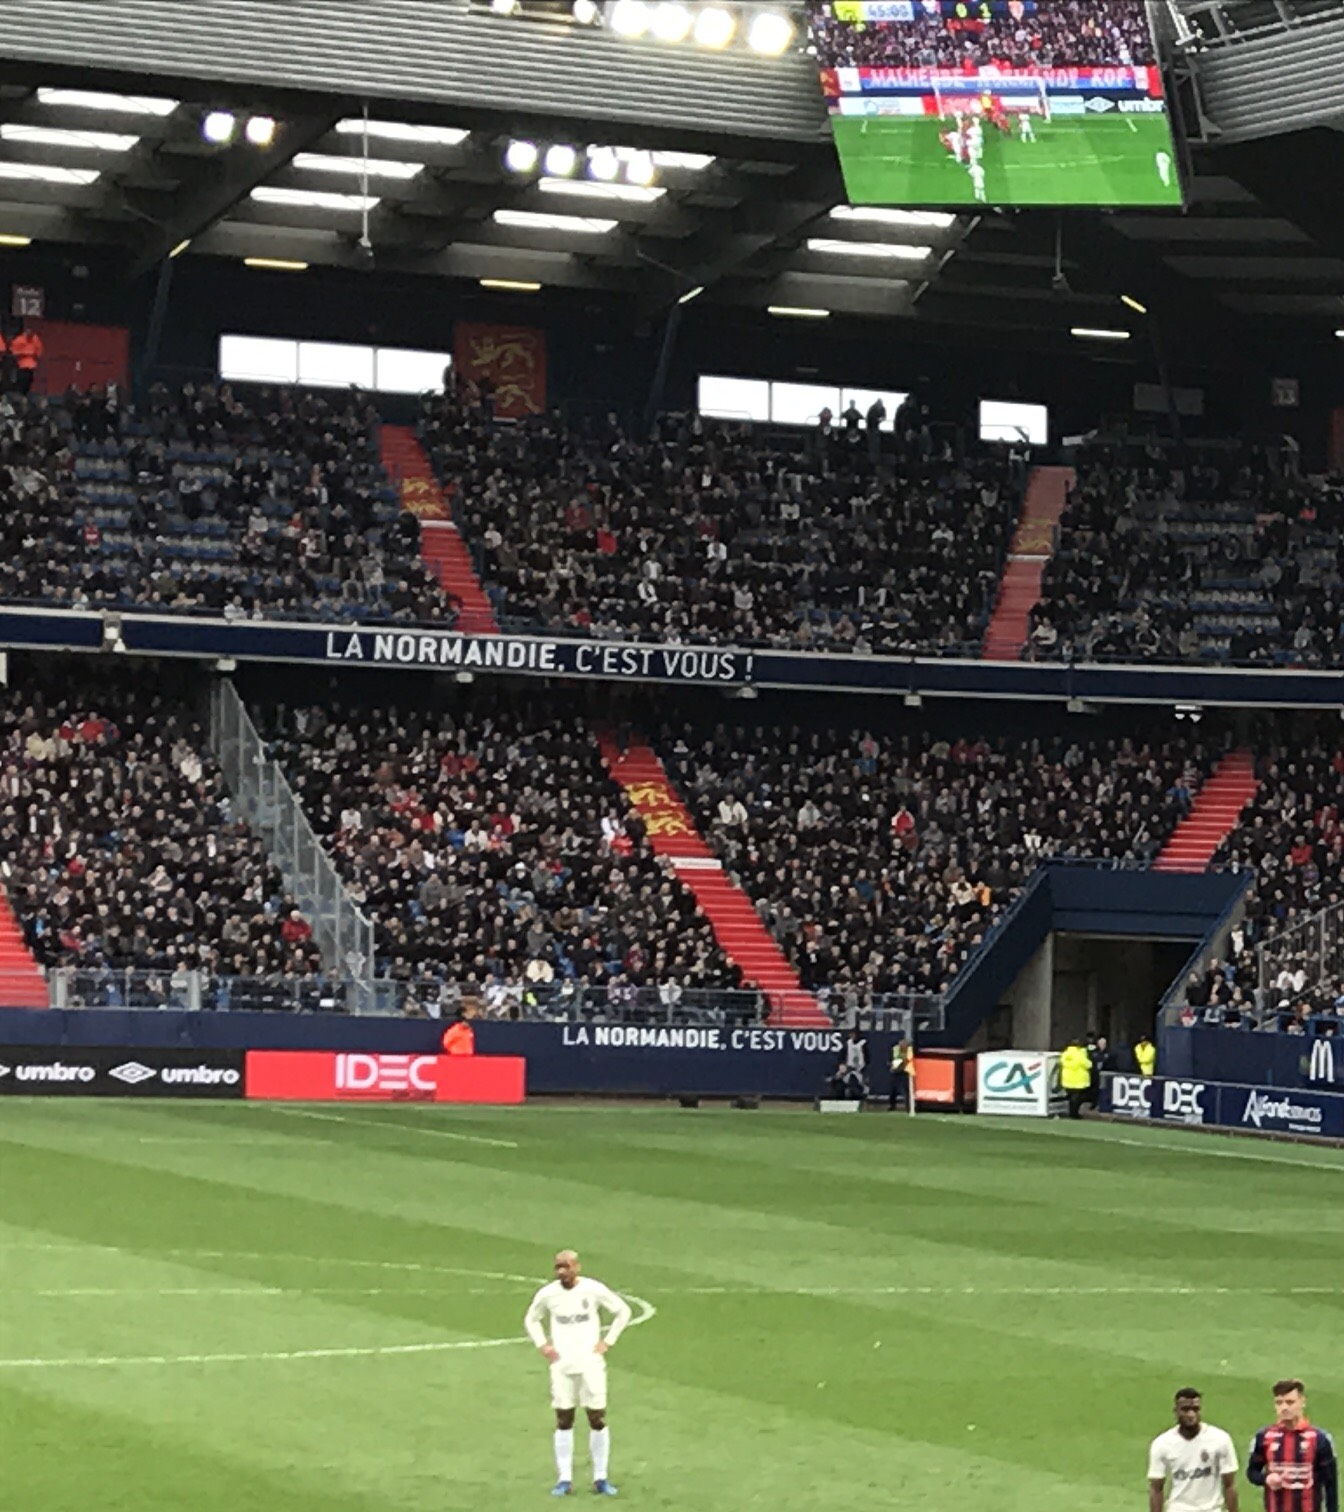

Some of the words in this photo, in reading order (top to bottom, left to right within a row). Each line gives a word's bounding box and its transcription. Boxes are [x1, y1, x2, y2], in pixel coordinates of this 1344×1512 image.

[326, 632, 364, 659] LA
[576, 646, 654, 675] C'EST
[663, 651, 735, 680] VOUS
[563, 1026, 589, 1046] LA
[731, 1029, 786, 1051] C'EST
[792, 1032, 843, 1052] VOUS
[16, 1062, 95, 1082] umbro
[161, 1065, 240, 1084] umbro
[335, 1054, 438, 1090] IDEC
[1112, 1075, 1151, 1109] IDEC
[1164, 1080, 1205, 1115] IDEC
